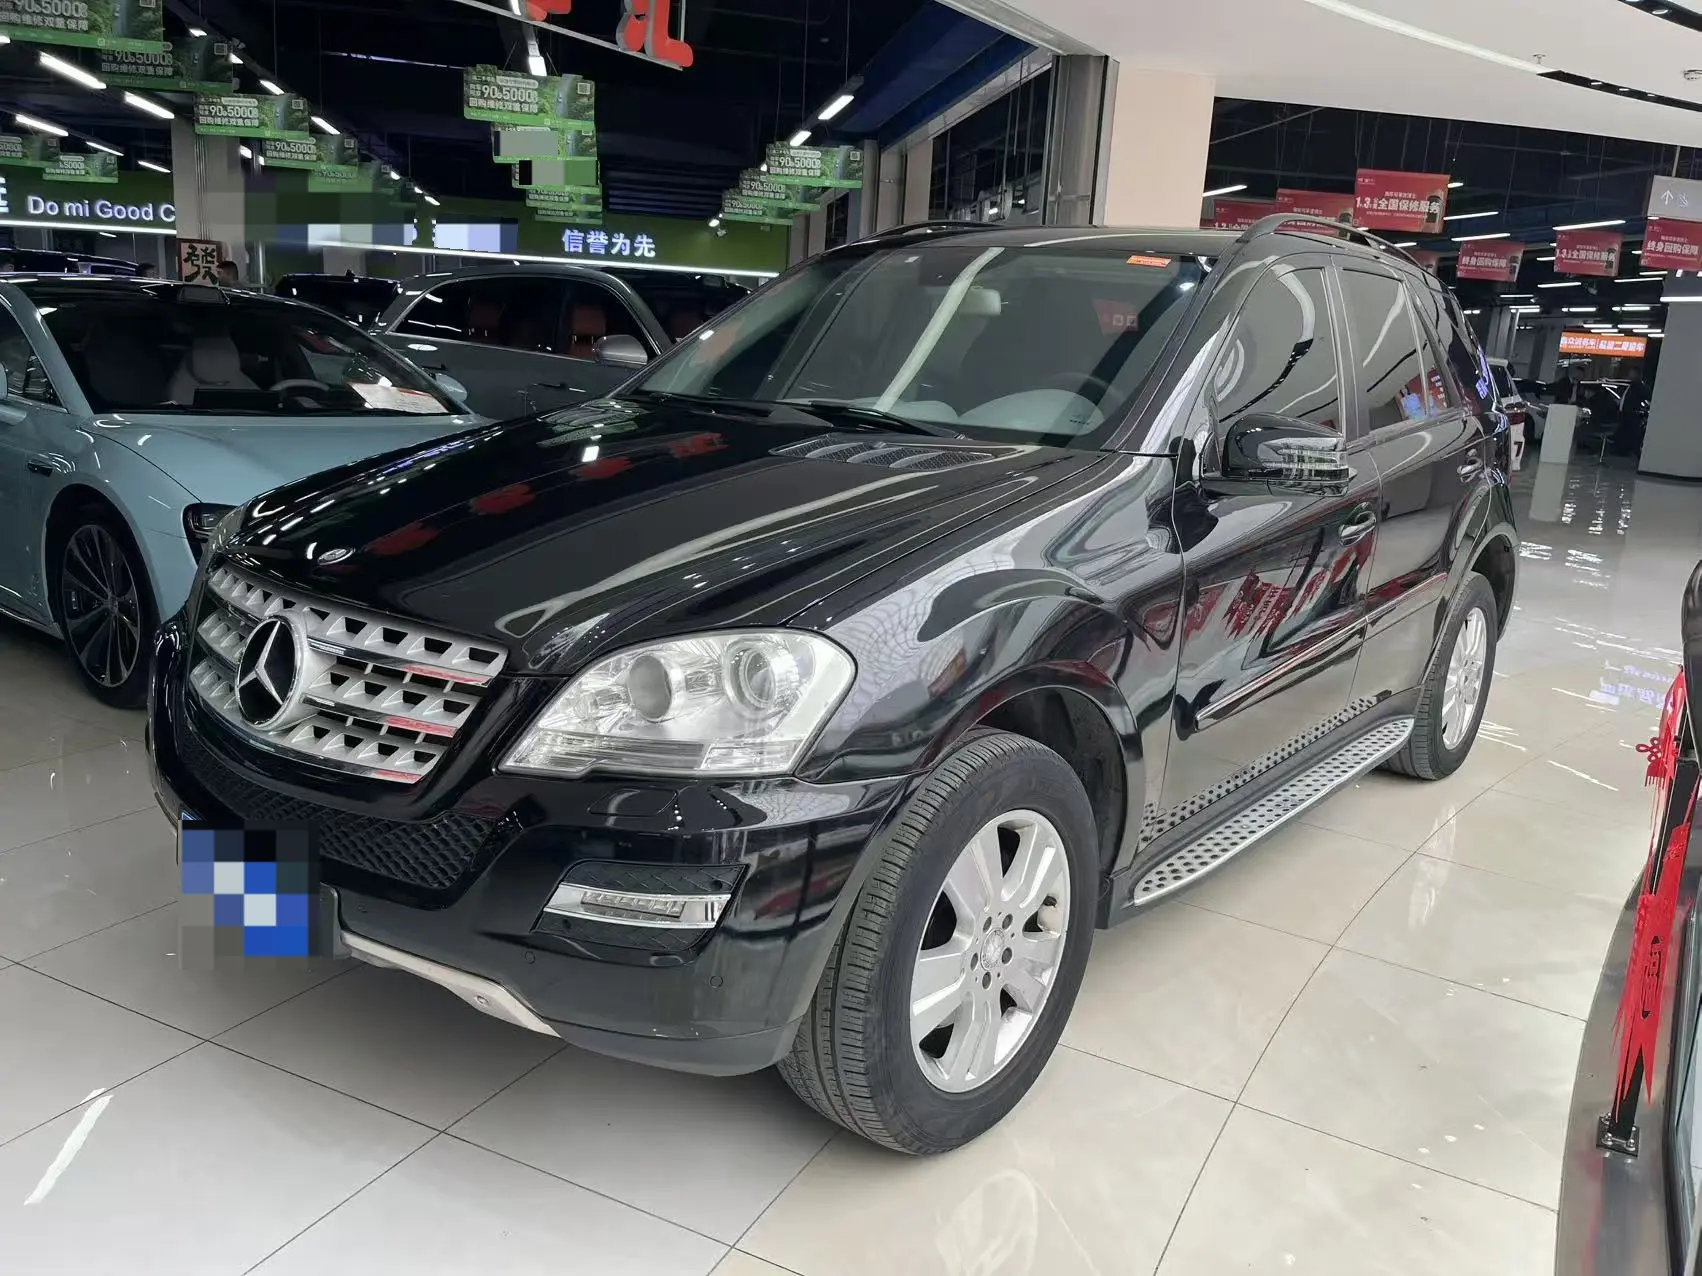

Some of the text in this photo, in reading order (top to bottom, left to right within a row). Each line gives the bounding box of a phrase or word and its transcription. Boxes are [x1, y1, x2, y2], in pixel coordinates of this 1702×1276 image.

[27, 195, 59, 214] Do
[64, 199, 89, 217] mi
[96, 200, 153, 221] Good
[562, 228, 656, 258] 信誉为先
